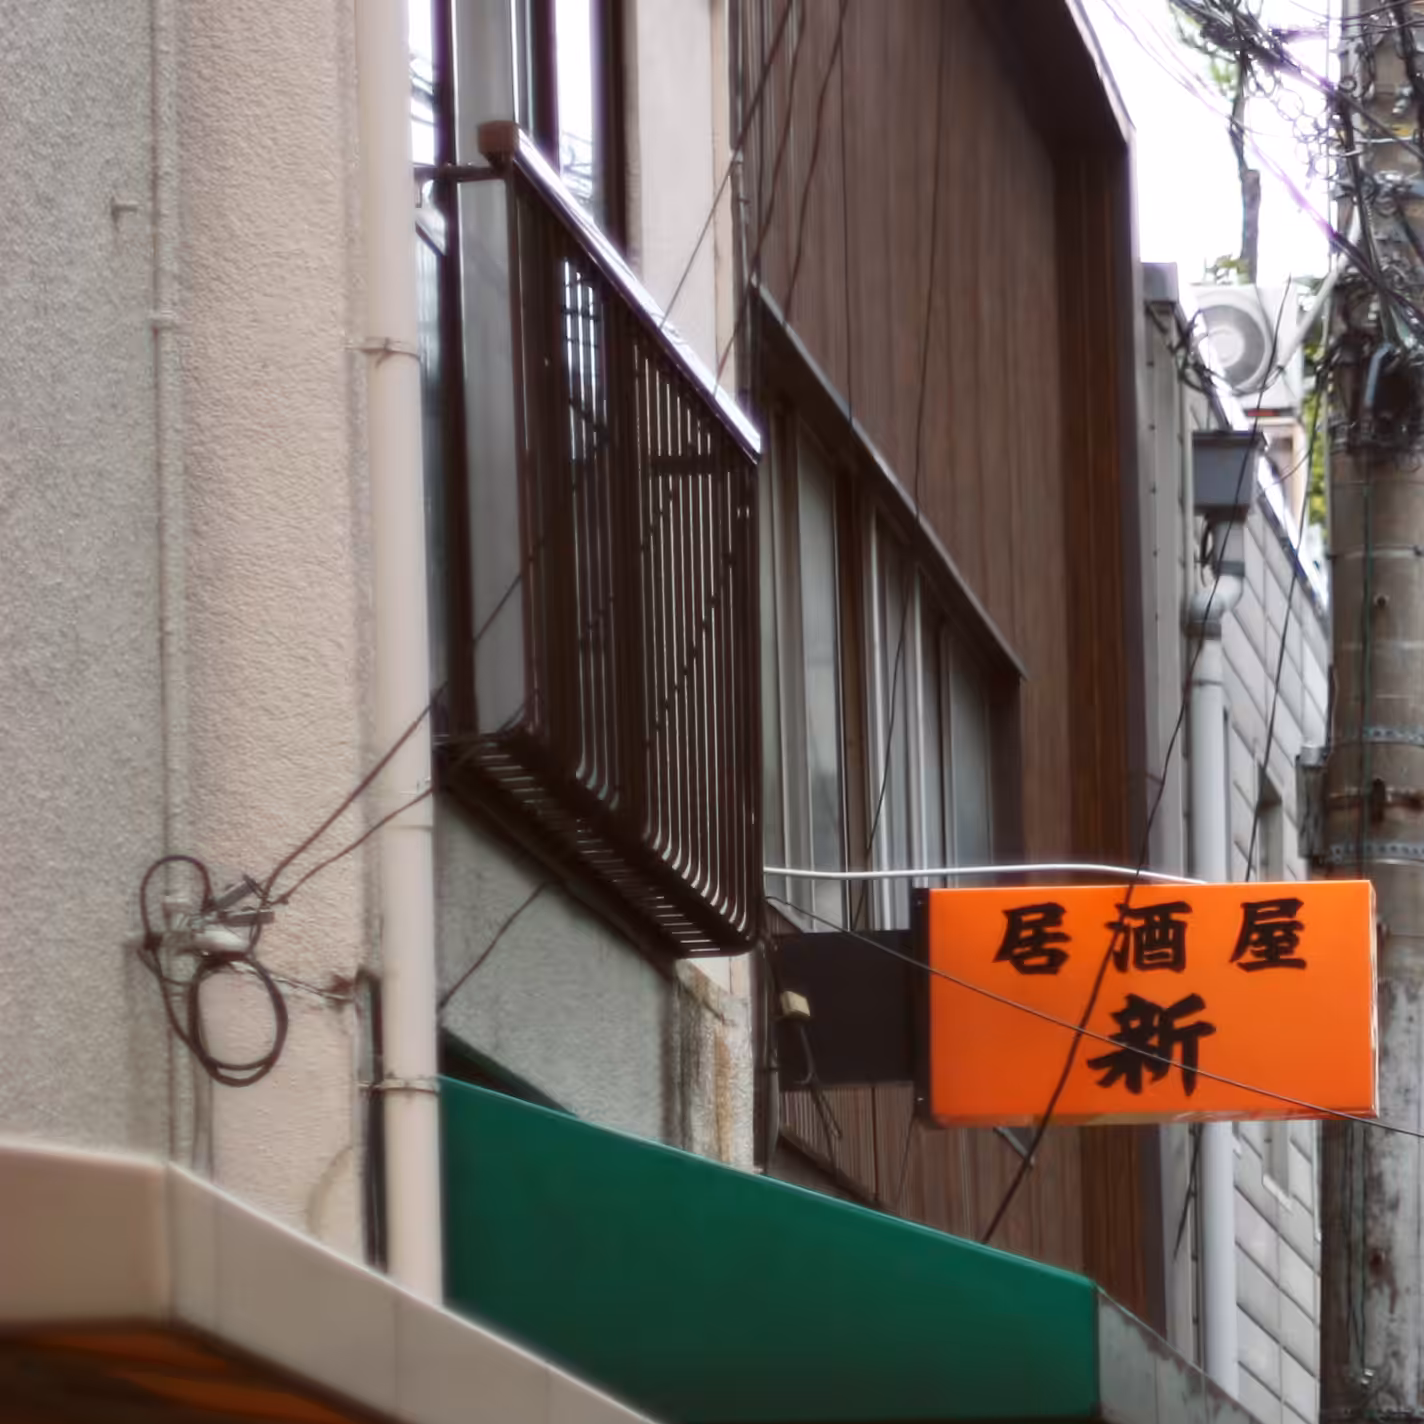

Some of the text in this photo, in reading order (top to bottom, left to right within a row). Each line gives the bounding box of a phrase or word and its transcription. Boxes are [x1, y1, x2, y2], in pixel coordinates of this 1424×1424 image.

[993, 897, 1308, 976] 居酒屋
[1086, 993, 1217, 1097] 新
